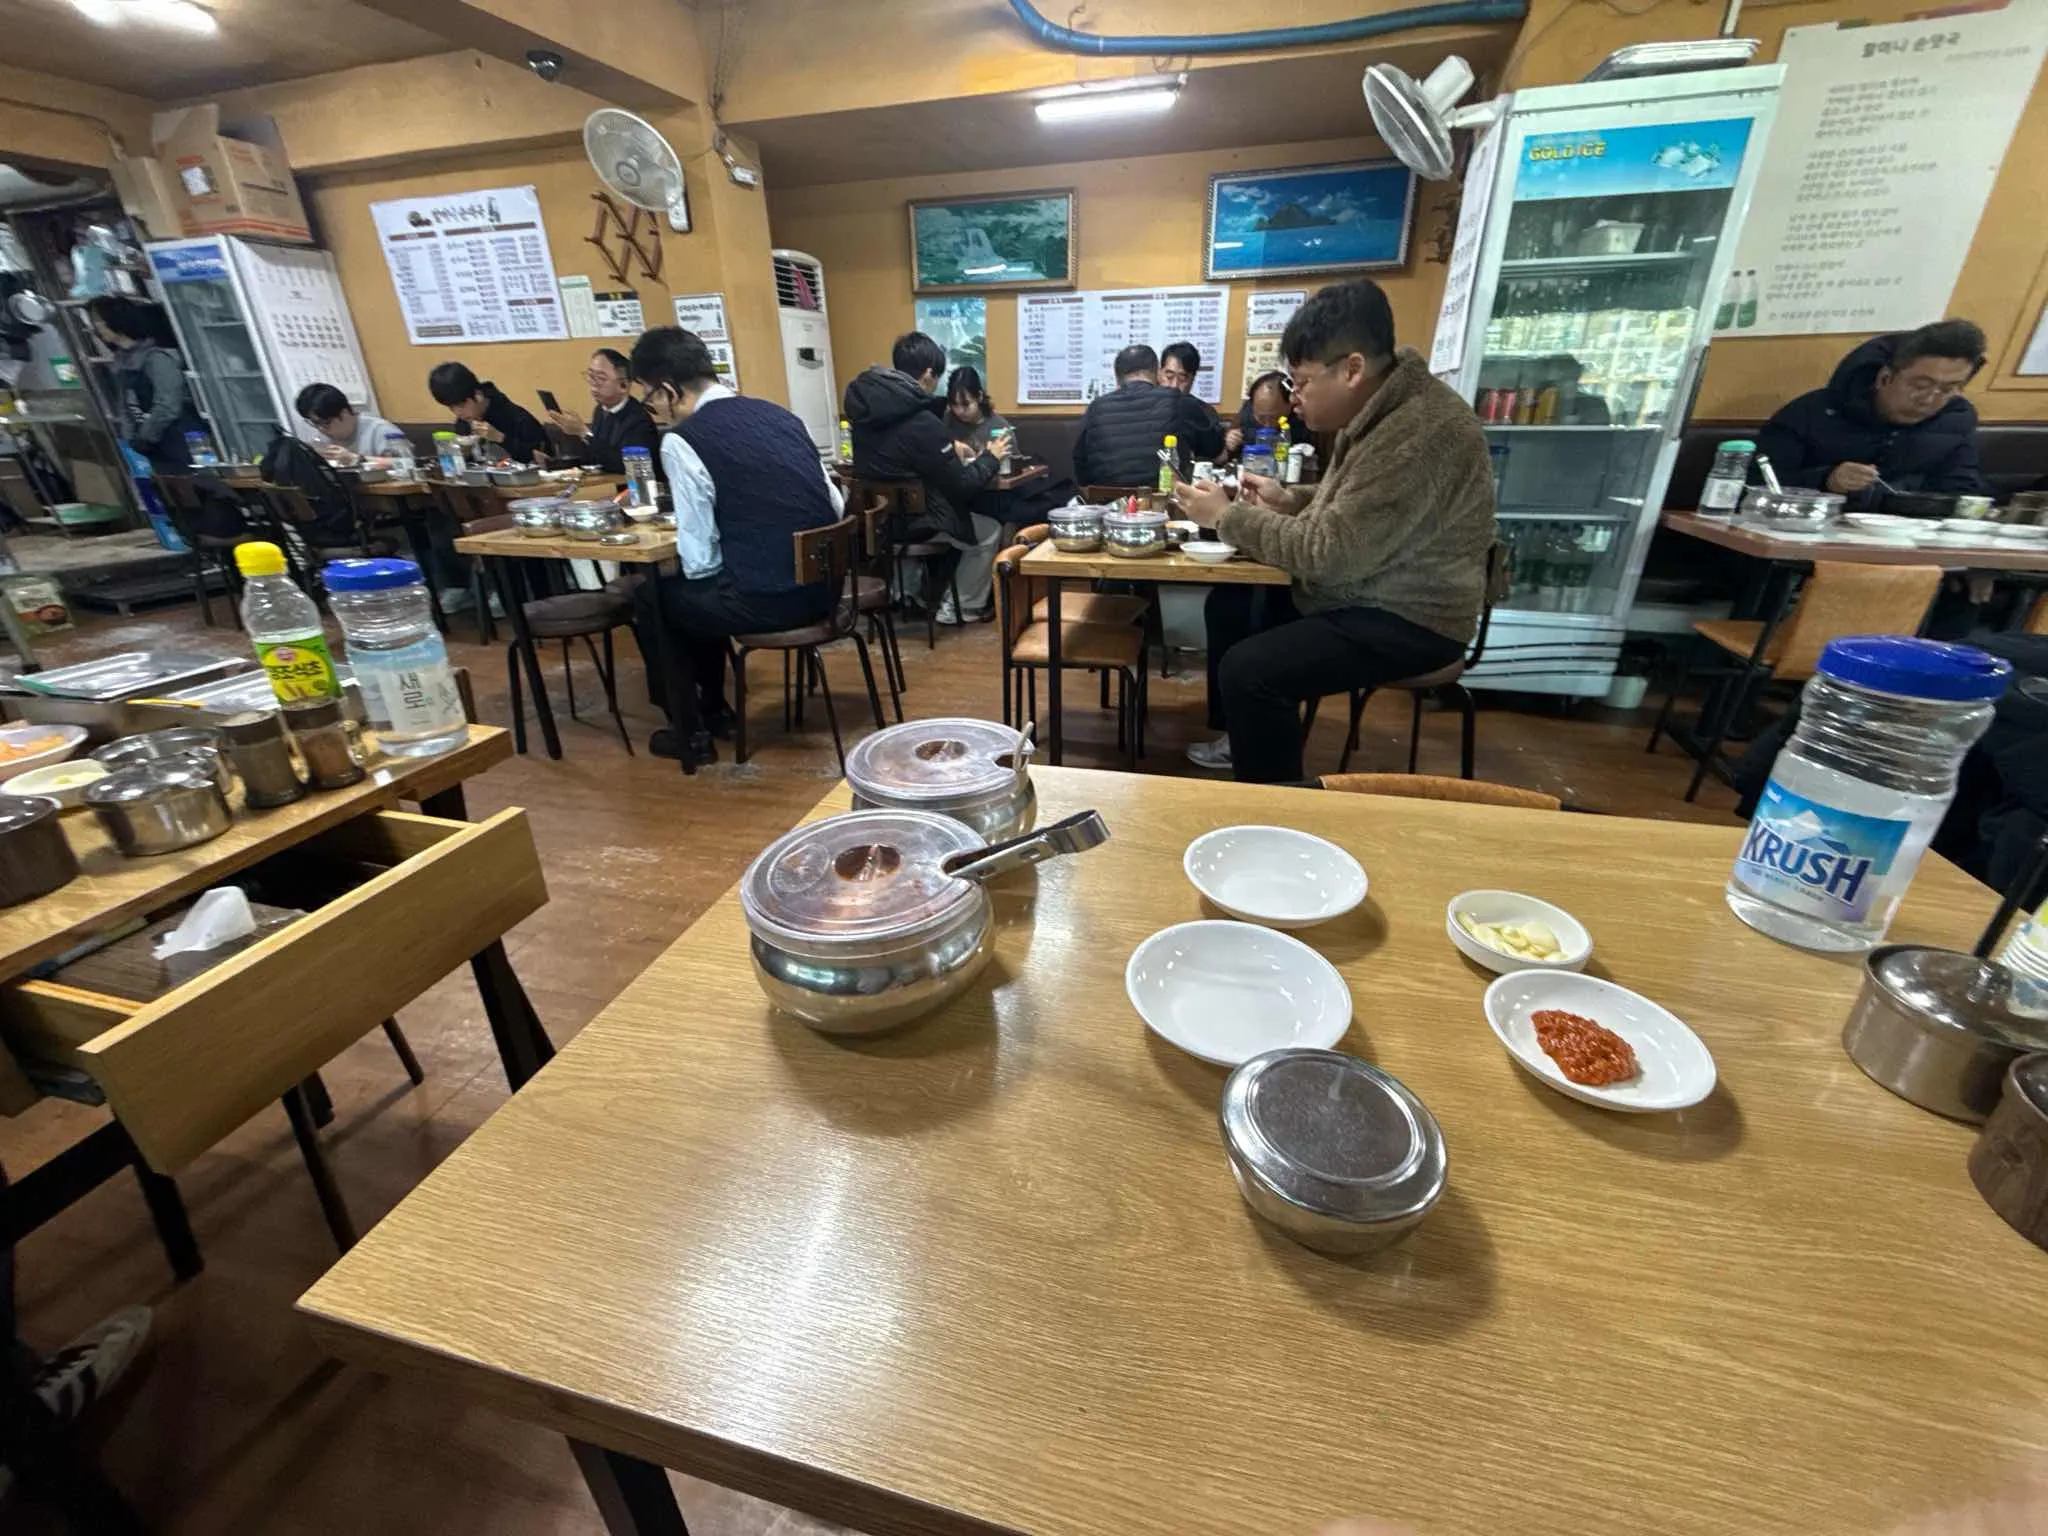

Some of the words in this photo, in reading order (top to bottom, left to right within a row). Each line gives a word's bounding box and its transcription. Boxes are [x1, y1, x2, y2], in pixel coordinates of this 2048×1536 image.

[1529, 144, 1574, 161] GOLD
[1577, 142, 1606, 157] ICE
[1742, 819, 1870, 902] KRUSH
